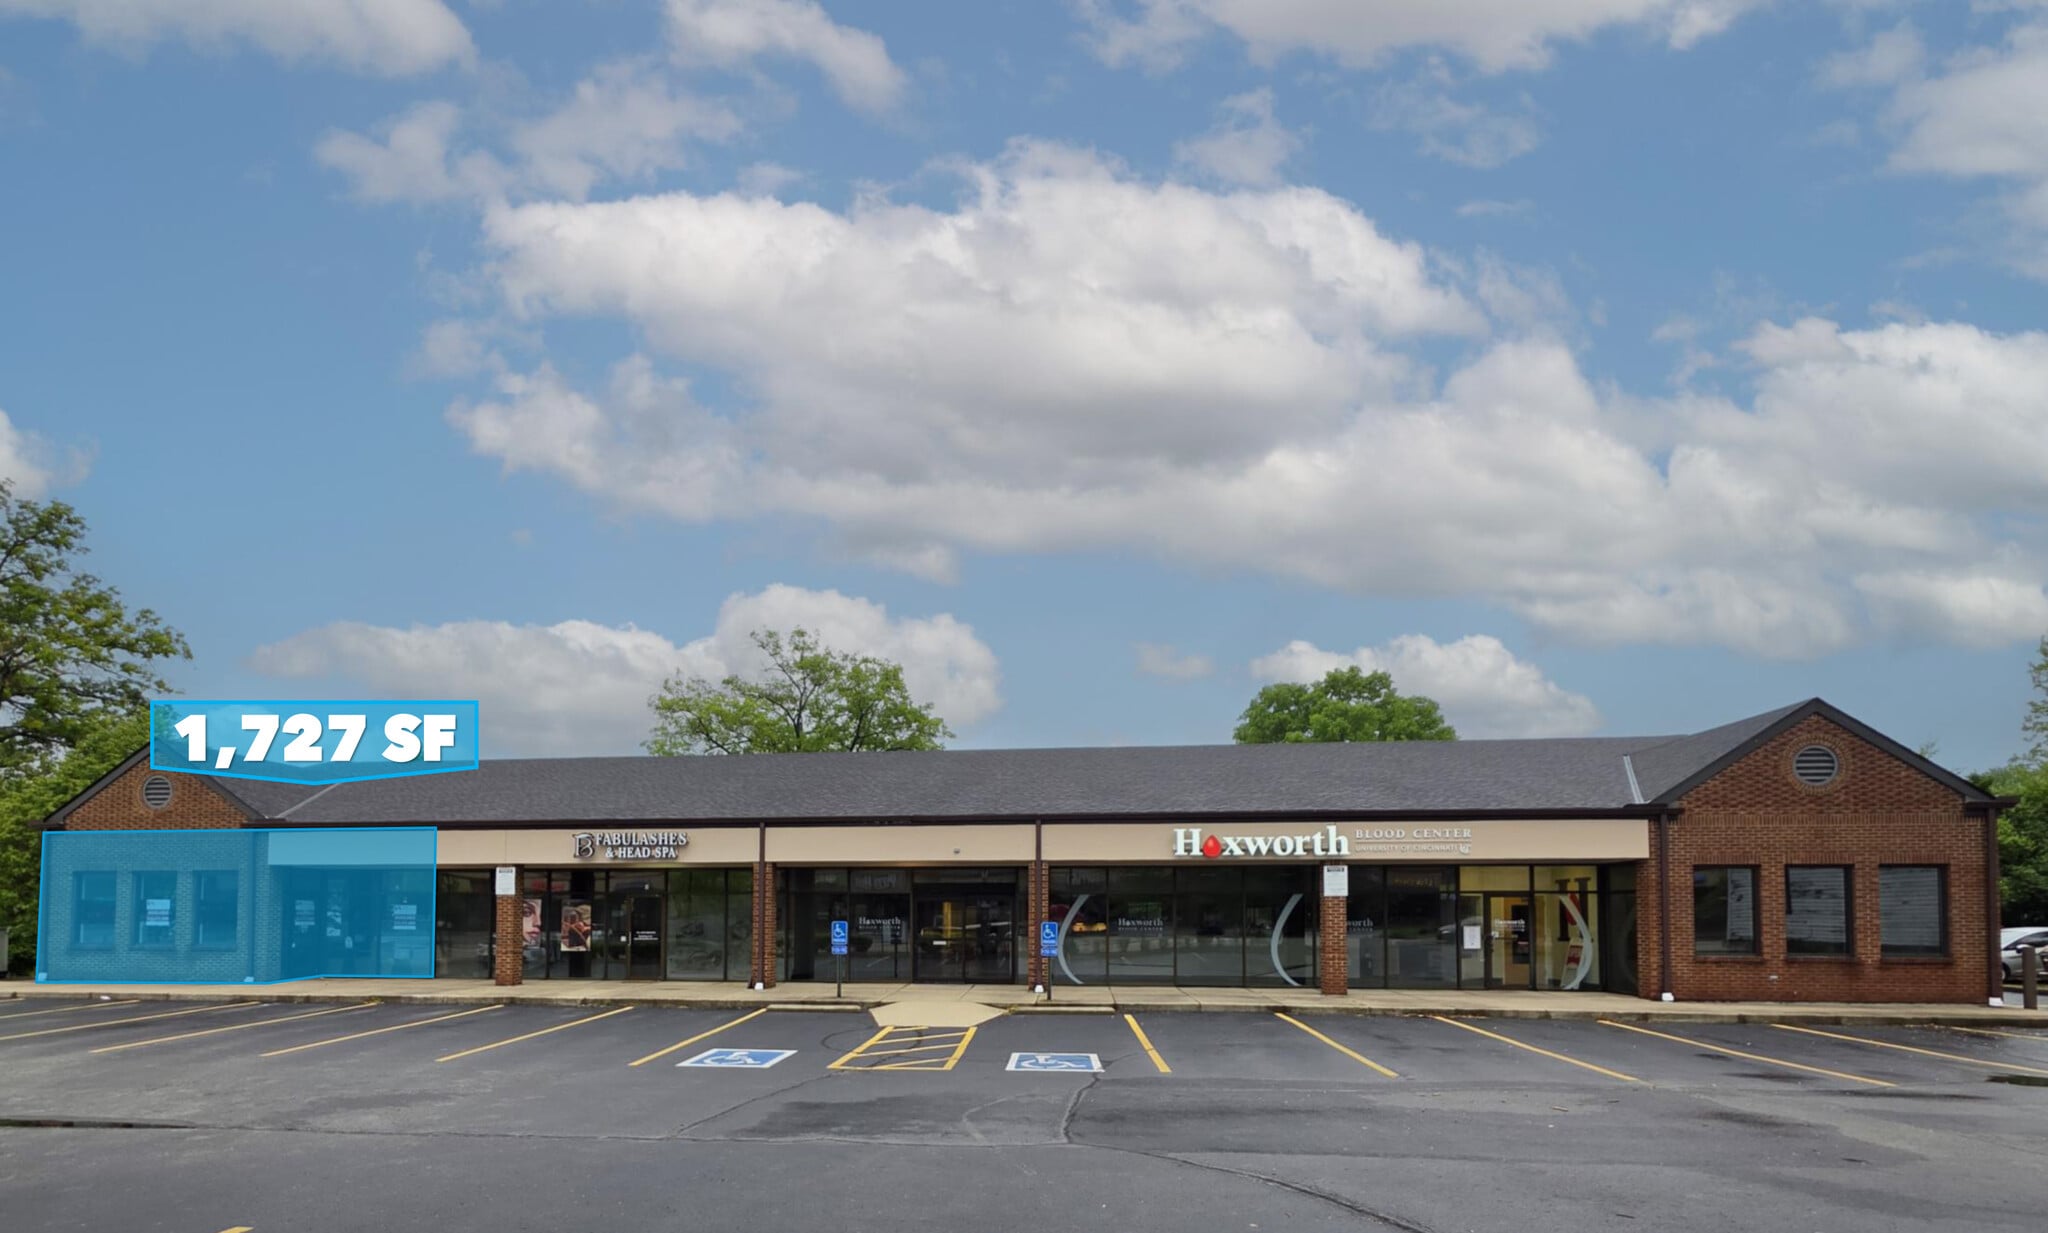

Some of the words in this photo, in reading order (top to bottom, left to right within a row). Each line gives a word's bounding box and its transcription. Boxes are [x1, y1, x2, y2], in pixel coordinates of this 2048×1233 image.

[596, 832, 688, 846] FABULASHES
[1355, 829, 1406, 839] BLOOD
[1413, 828, 1472, 838] CENTER
[605, 846, 614, 858] &
[618, 847, 651, 858] HEAD
[654, 847, 677, 858] SPA
